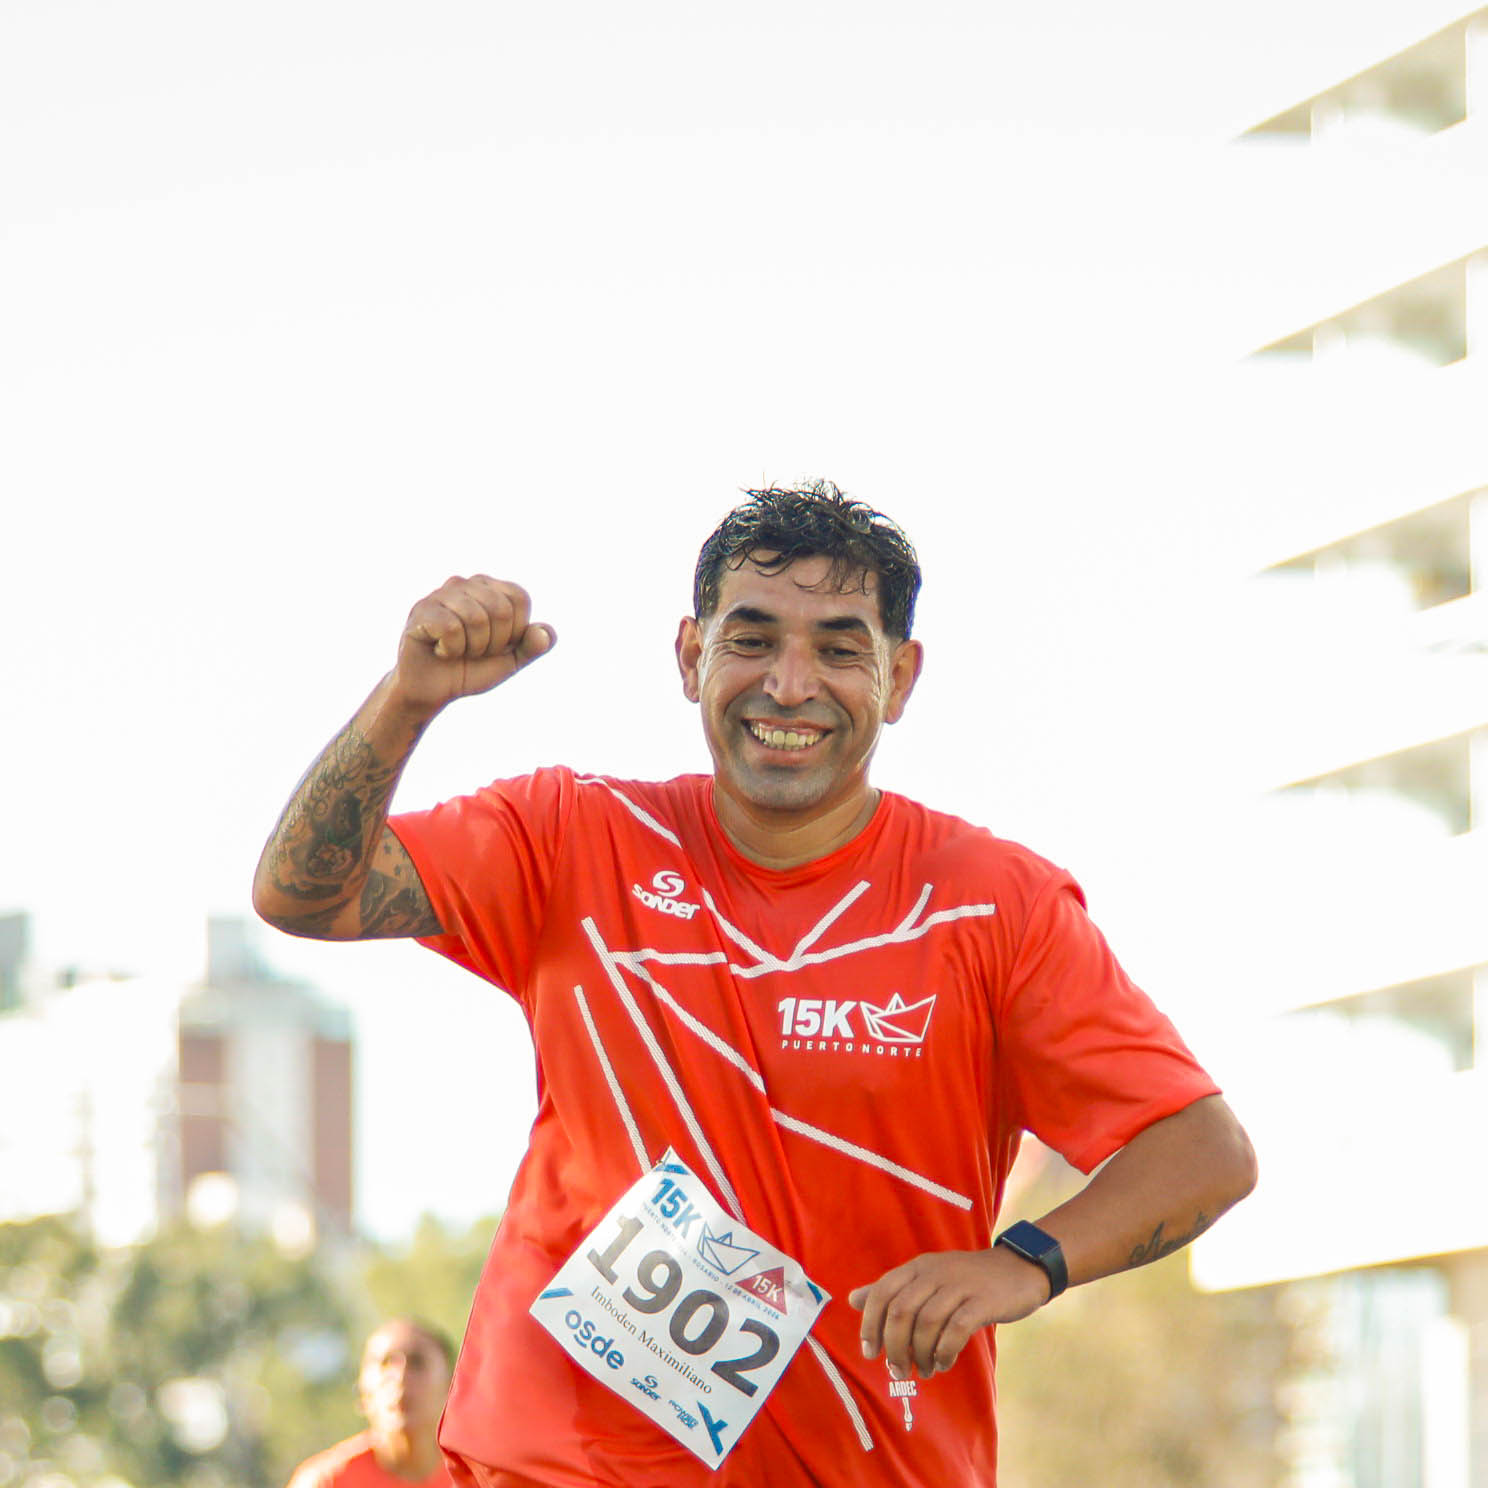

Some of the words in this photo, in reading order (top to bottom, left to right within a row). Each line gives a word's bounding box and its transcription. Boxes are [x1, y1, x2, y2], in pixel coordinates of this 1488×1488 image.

[777, 996, 857, 1039] 15K
[781, 1039, 854, 1052] PUERTO
[862, 1043, 923, 1058] NORTE
[650, 1178, 703, 1240] 15K
[587, 1215, 781, 1398] 1902
[752, 1275, 783, 1303] 15K
[565, 1309, 625, 1370] osde
[591, 1286, 638, 1335] Imboden
[638, 1330, 713, 1394] Maximiliano
